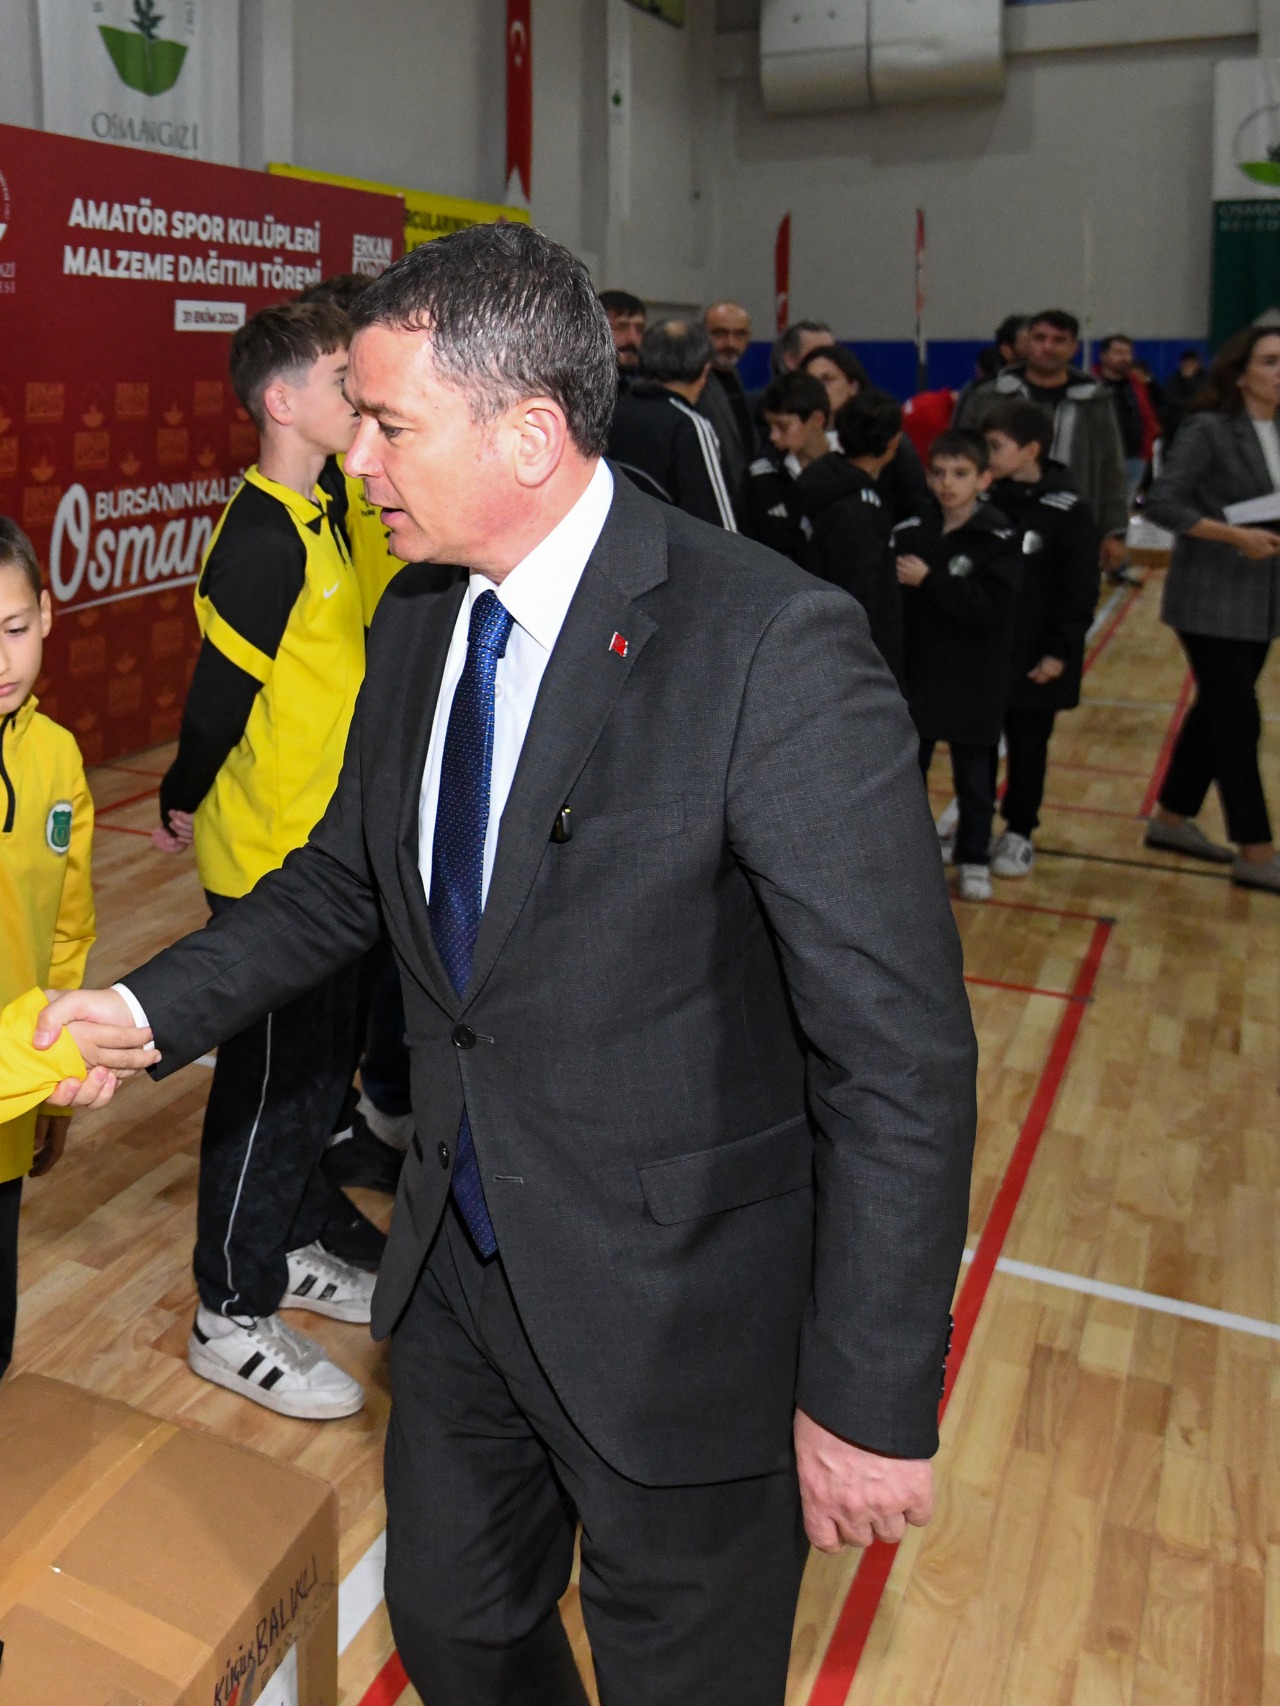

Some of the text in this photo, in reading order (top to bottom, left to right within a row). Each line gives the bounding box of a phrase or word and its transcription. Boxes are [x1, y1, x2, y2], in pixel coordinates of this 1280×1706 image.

[68, 198, 320, 254] AMATÖR SPOR KULÜPLERİ
[63, 245, 176, 283] MALZEME
[178, 250, 257, 288] DAĞITIM
[95, 482, 194, 522] BURSA'NIN
[49, 483, 213, 602] Osman
